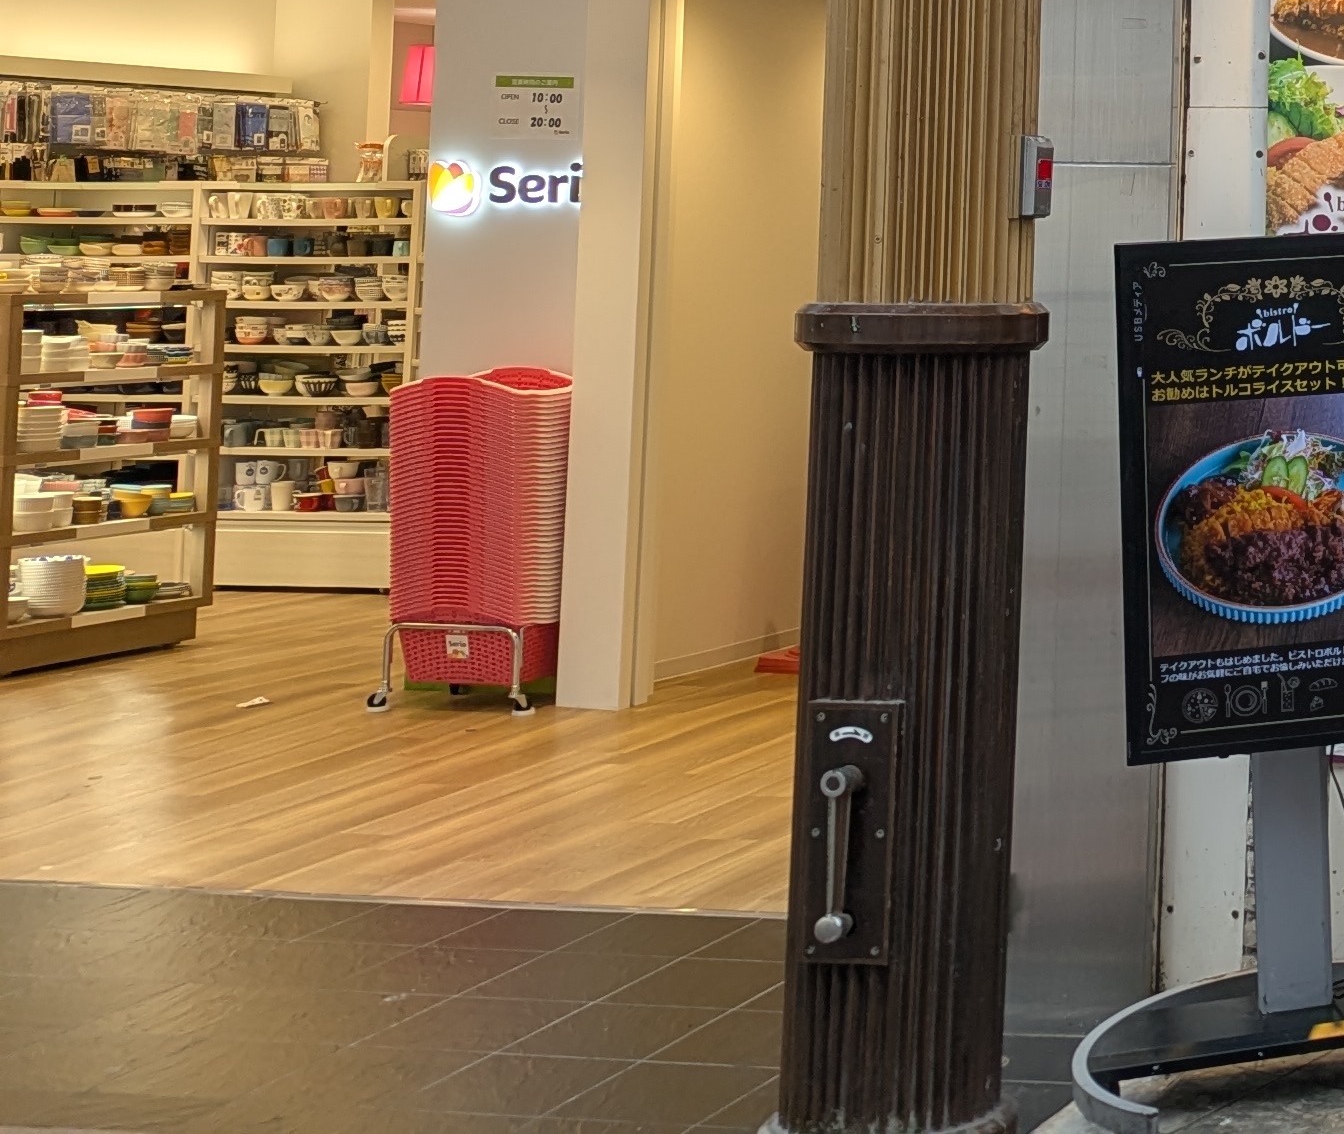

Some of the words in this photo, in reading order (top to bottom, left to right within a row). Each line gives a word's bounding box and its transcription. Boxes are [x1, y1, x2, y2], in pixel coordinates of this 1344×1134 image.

[532, 92, 563, 103] 10:00
[530, 117, 562, 128] 20:00
[1263, 306, 1292, 319] bistro
[1236, 315, 1331, 352] ボルドー
